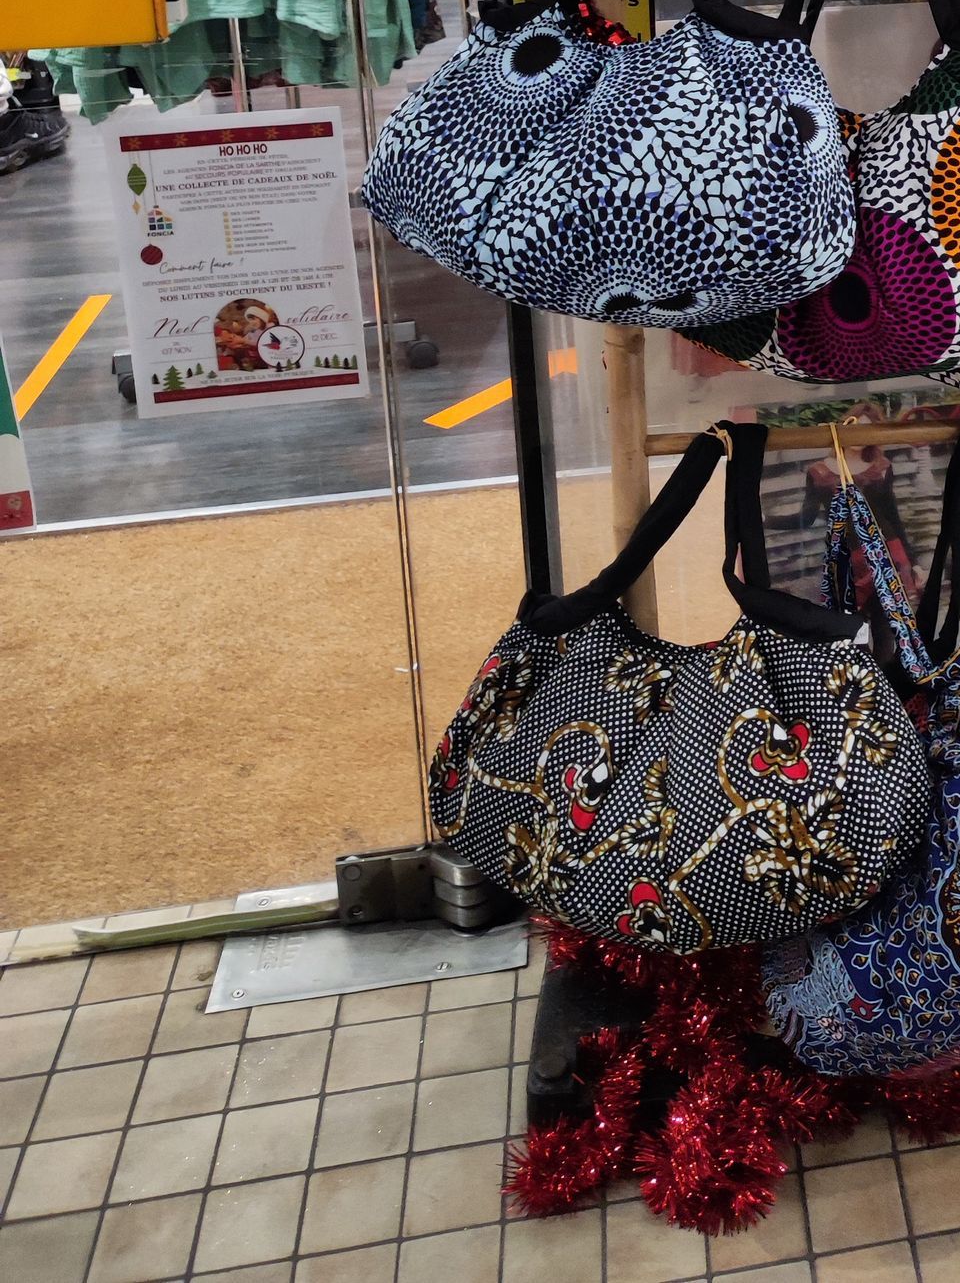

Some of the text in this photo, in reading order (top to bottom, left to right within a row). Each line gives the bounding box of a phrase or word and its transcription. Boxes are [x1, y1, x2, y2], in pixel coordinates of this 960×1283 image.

[218, 143, 268, 157] HO HO HO
[156, 184, 176, 192] UNE
[178, 179, 229, 190] COLLECTE
[232, 178, 245, 186] DE
[247, 175, 293, 184] CADEAUX
[296, 173, 309, 181] DE
[147, 230, 175, 238] FONCIA
[160, 294, 179, 302] NOS
[180, 291, 215, 301] LUTINS
[218, 285, 277, 297] S'OCCUPENT
[280, 284, 293, 292] DU
[296, 281, 327, 290] RESTE
